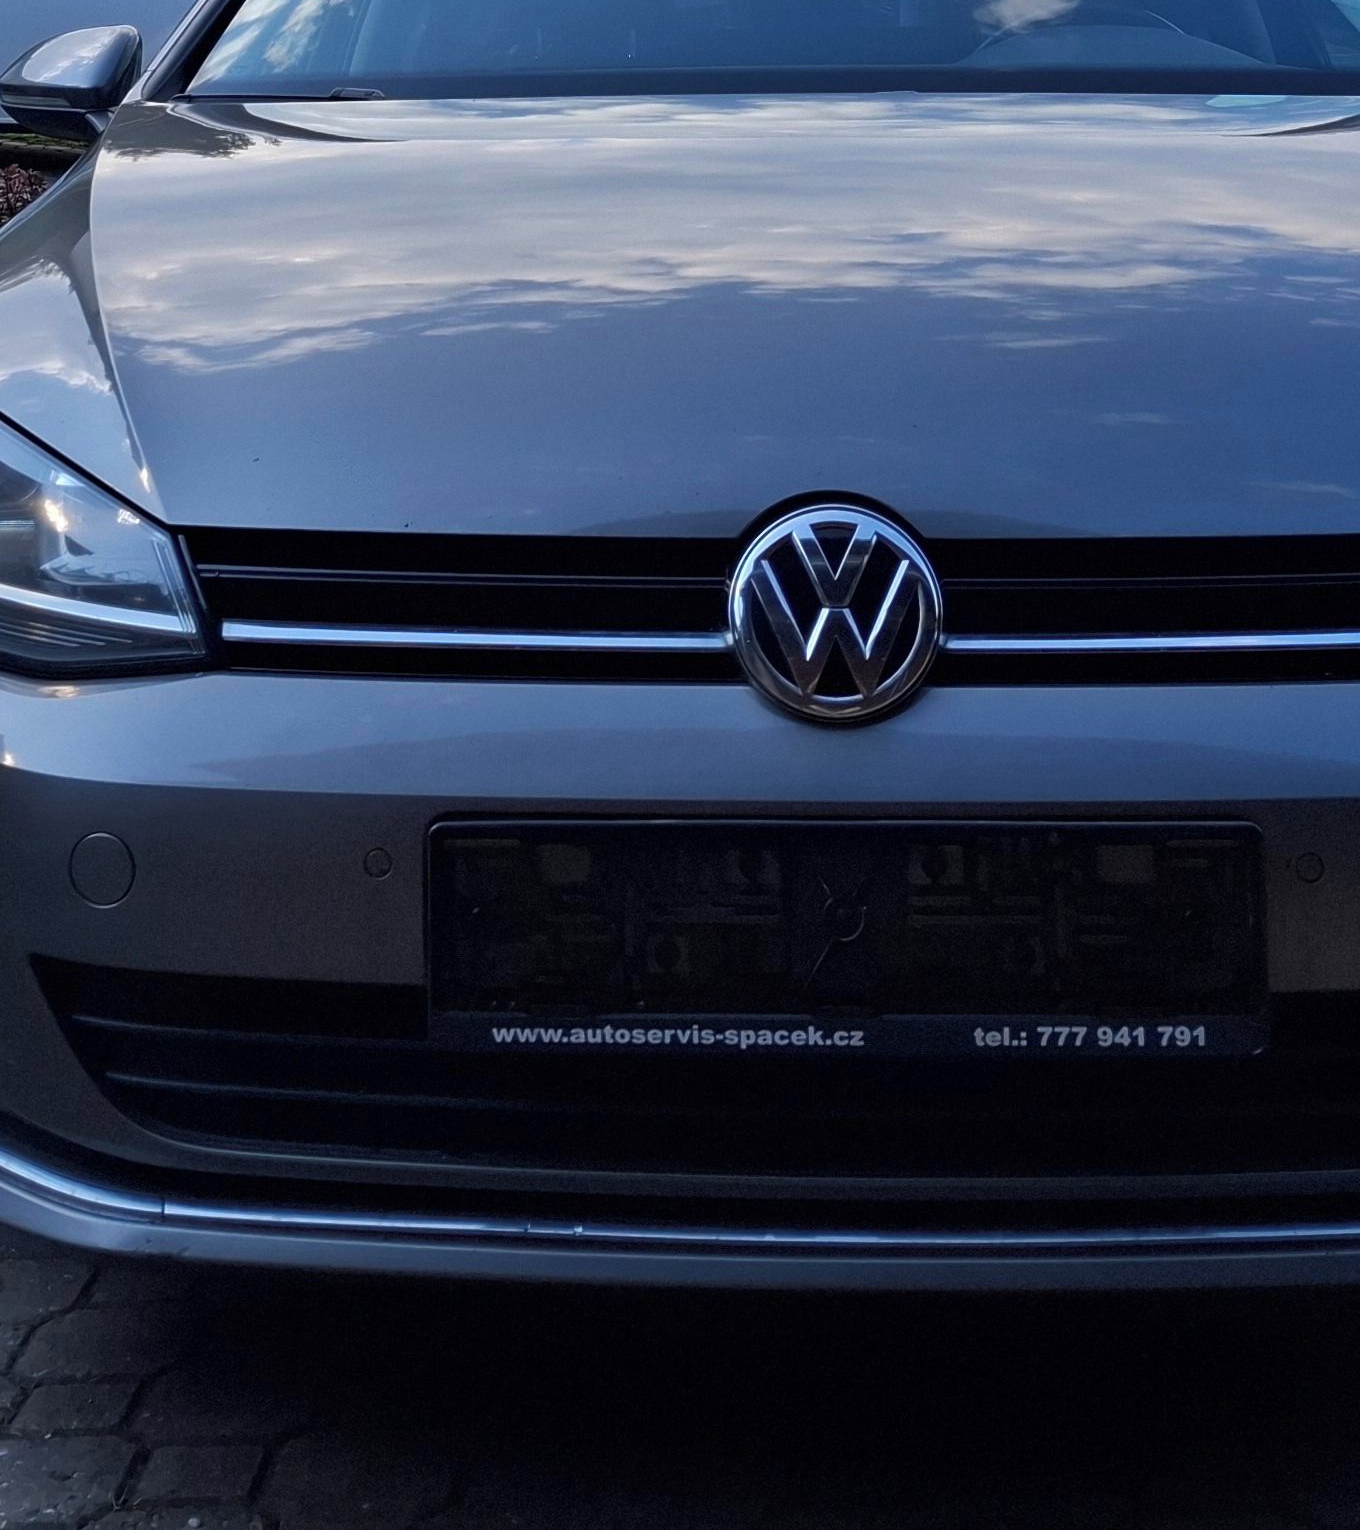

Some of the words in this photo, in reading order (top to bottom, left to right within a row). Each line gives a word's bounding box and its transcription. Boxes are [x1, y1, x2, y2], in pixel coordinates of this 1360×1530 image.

[740, 512, 931, 710] VW
[491, 1024, 865, 1050] www.autoservis-spacek.cz
[973, 1026, 1028, 1047] tel.:
[1037, 1026, 1088, 1047] 777
[1096, 1026, 1146, 1047] 941
[1157, 1026, 1206, 1047] 791
